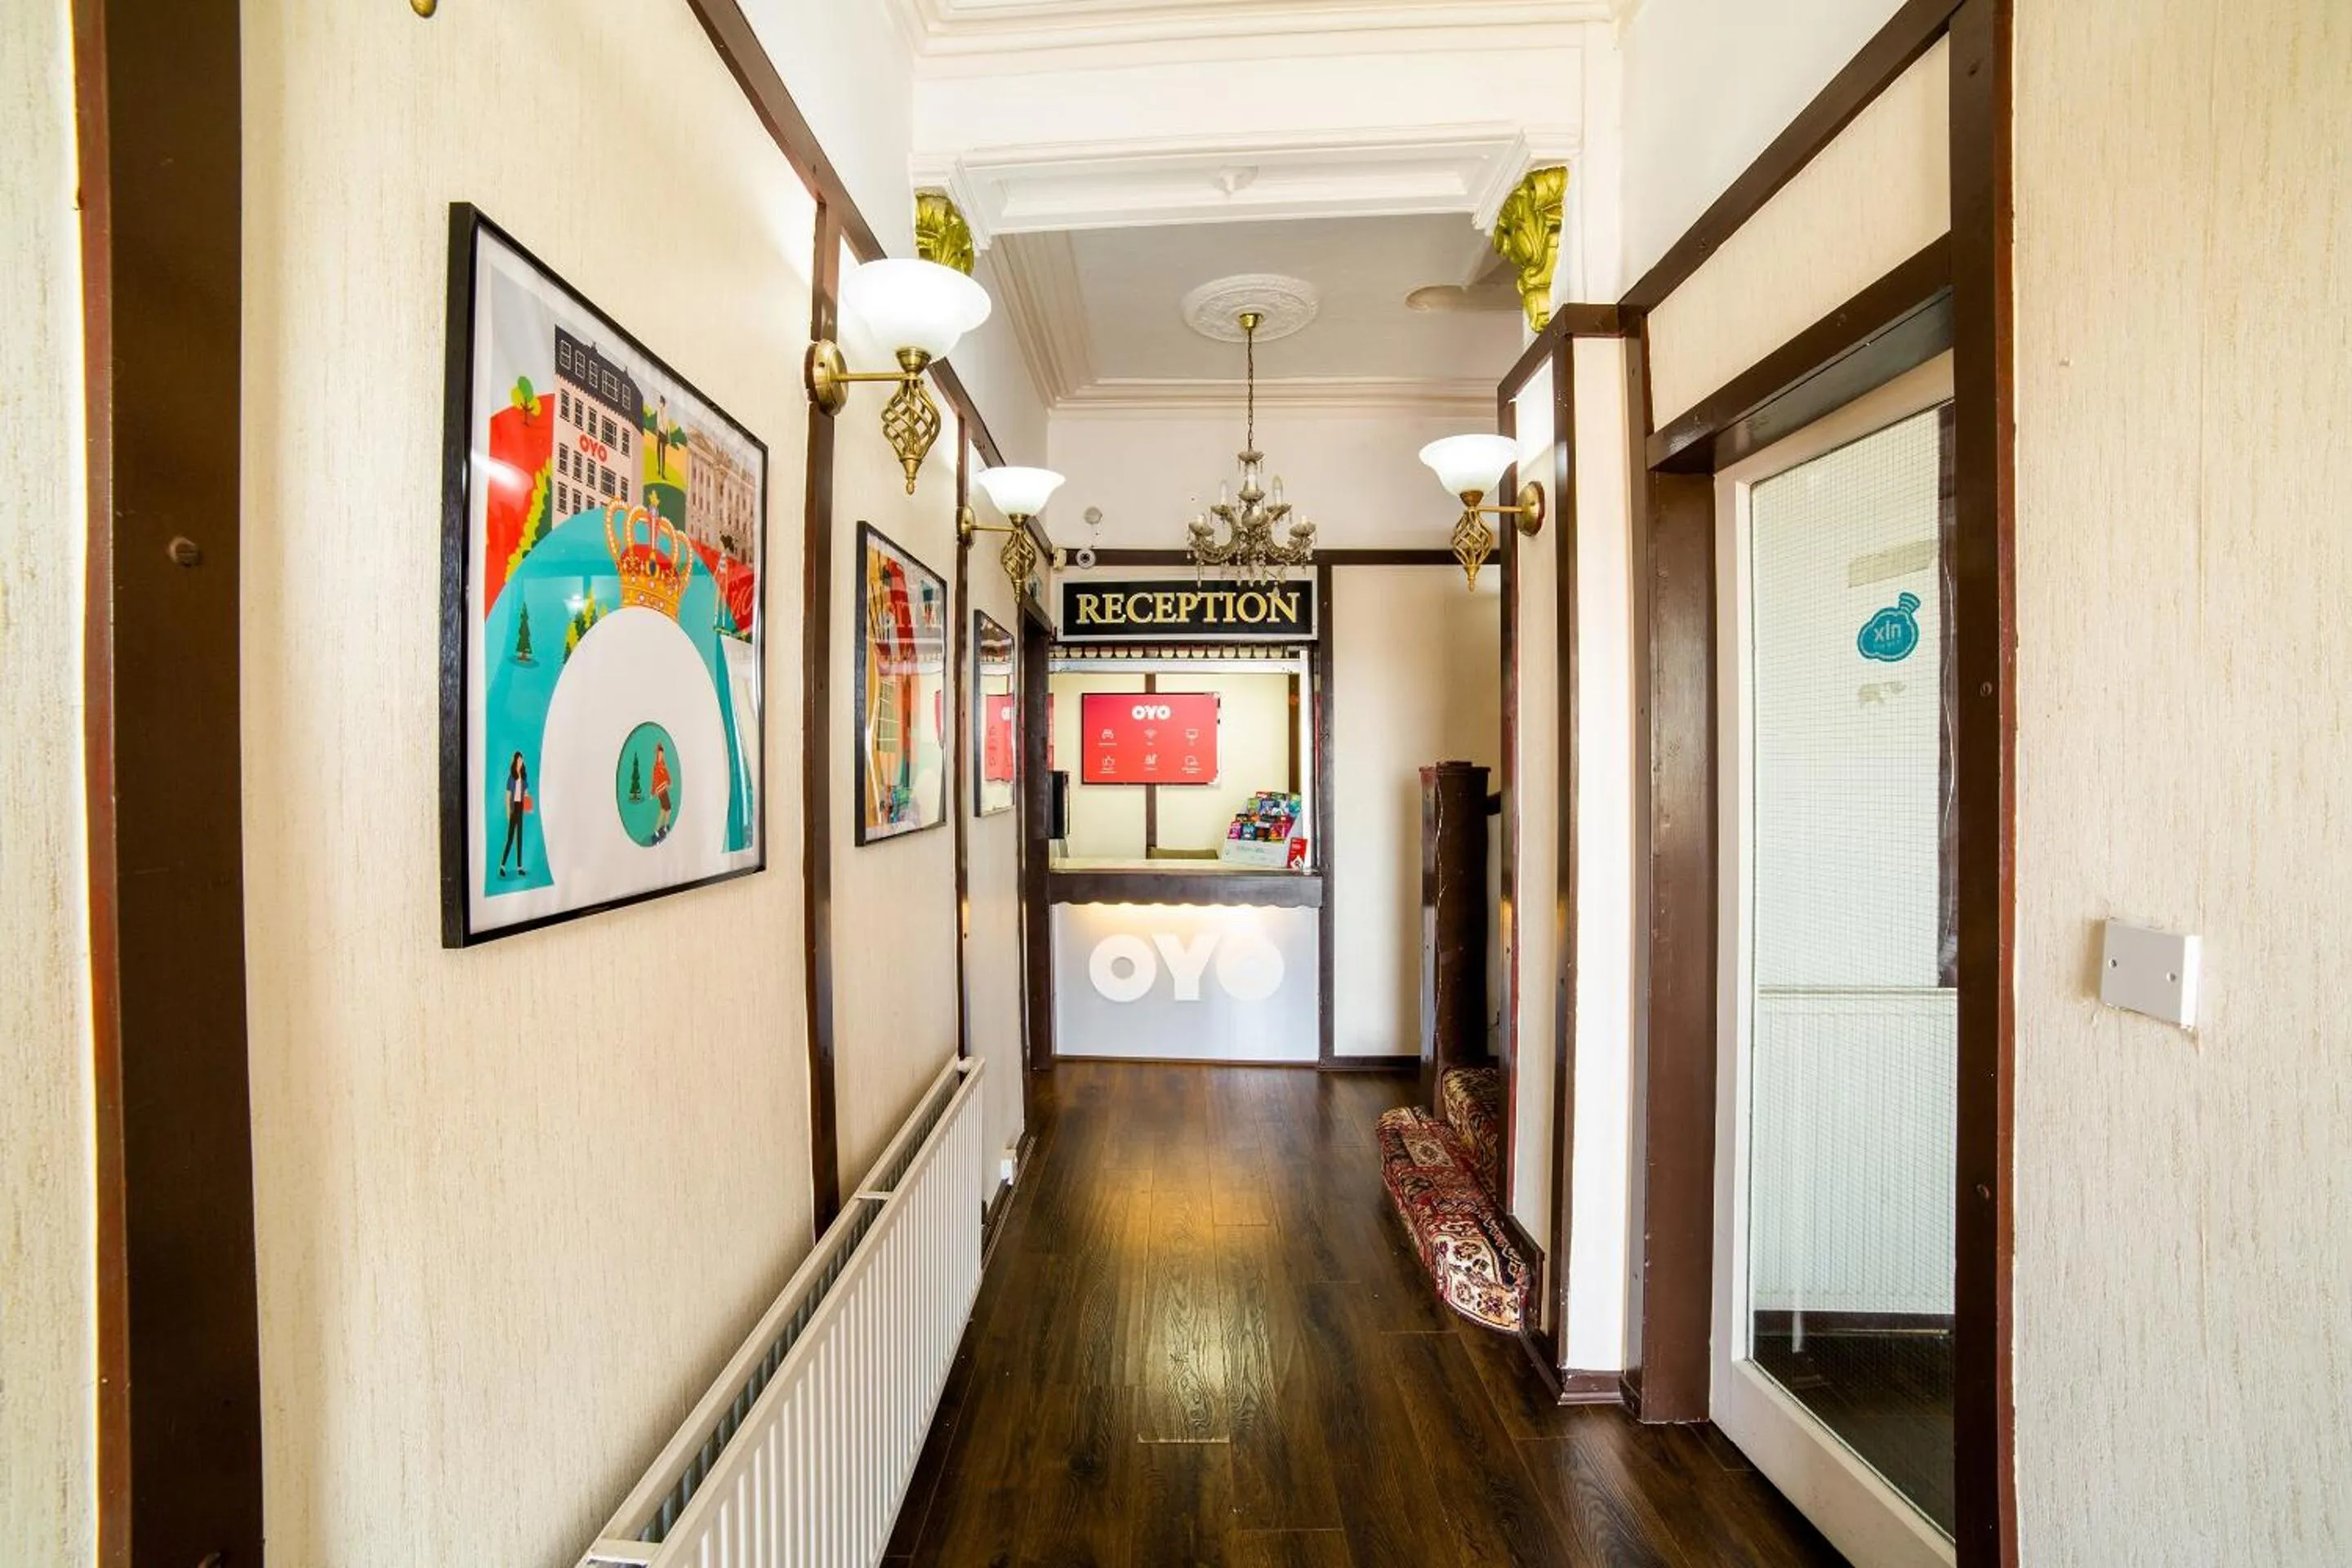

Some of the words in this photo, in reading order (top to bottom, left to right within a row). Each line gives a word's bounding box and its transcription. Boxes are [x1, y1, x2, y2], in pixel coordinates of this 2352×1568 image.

[579, 434, 608, 462] OYO
[1076, 592, 1300, 623] RECEPTION
[1132, 705, 1170, 720] OYO
[1089, 933, 1285, 1002] OYO
